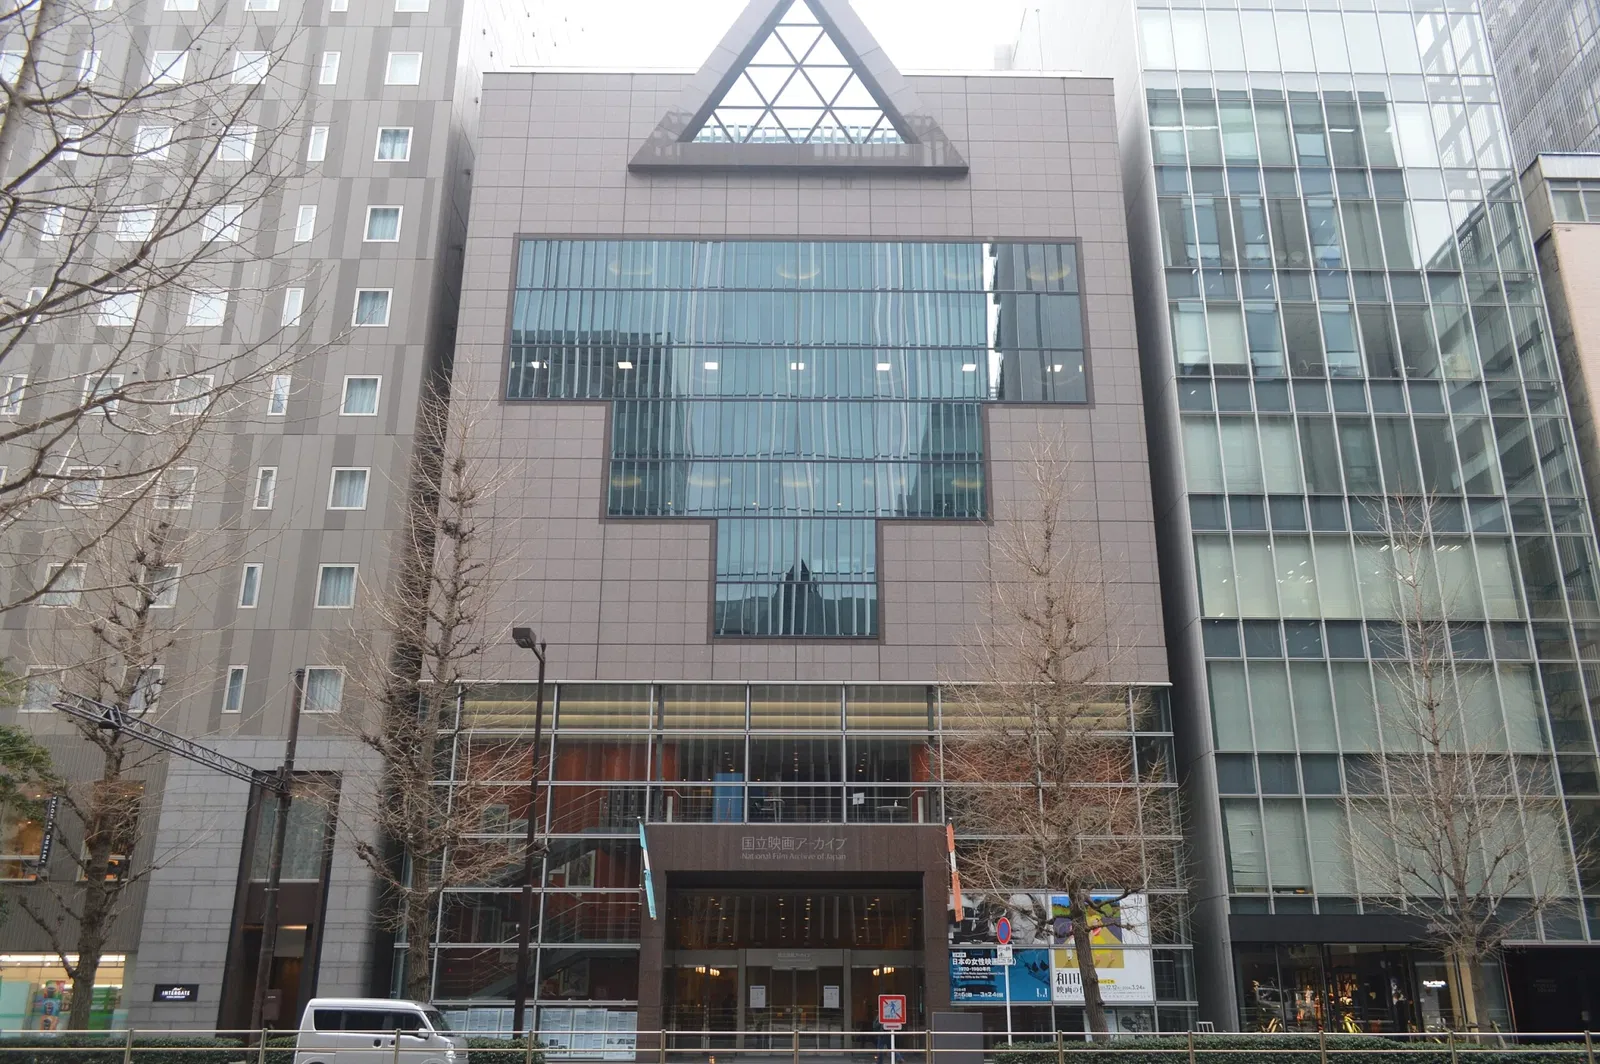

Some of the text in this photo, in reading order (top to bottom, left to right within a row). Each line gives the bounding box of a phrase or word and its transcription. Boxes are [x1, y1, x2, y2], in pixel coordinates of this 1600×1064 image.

[41, 822, 53, 863] INTERGTE
[741, 836, 848, 850] 国立映画アーカイブ
[741, 852, 847, 861] National Film Archive of Japan
